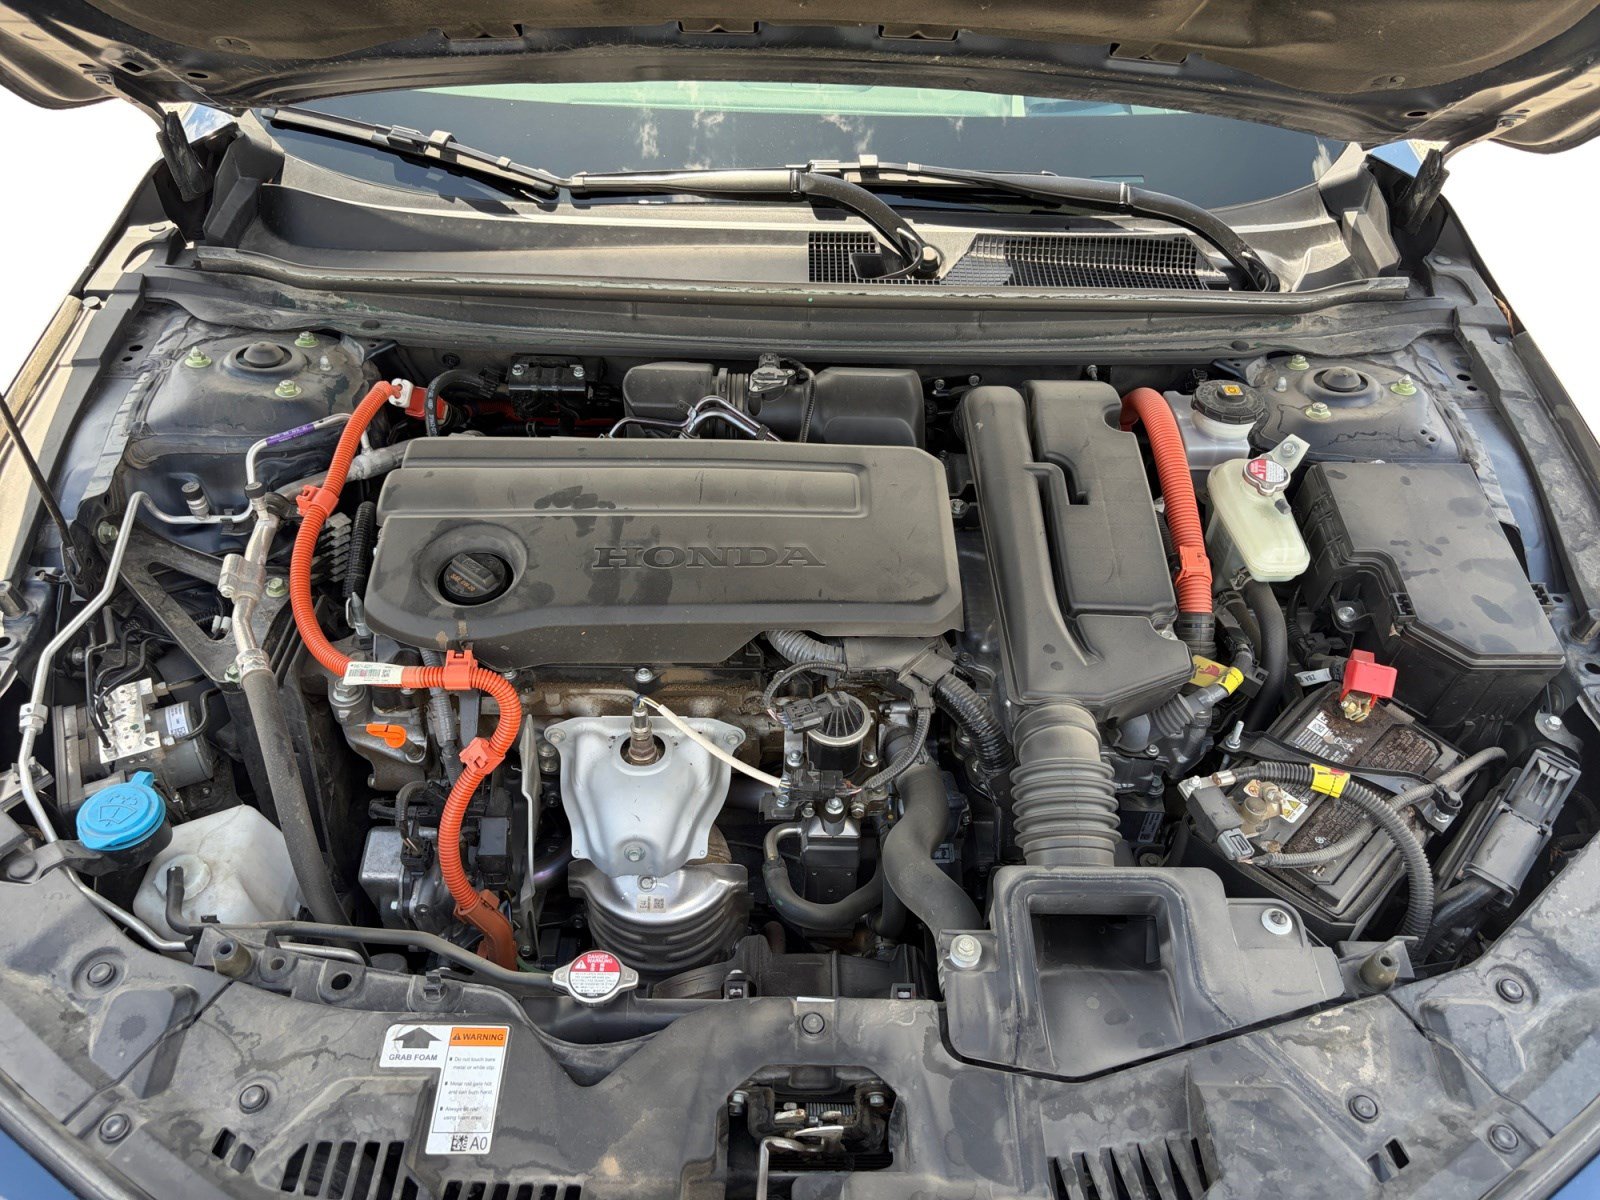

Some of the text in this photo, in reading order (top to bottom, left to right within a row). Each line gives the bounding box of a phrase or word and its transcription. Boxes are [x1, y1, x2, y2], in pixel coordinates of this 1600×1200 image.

[593, 546, 826, 569] HONDA
[463, 1033, 504, 1041] WARNING
[389, 1053, 438, 1061] GRAB FOAM
[470, 1136, 488, 1150] A0
